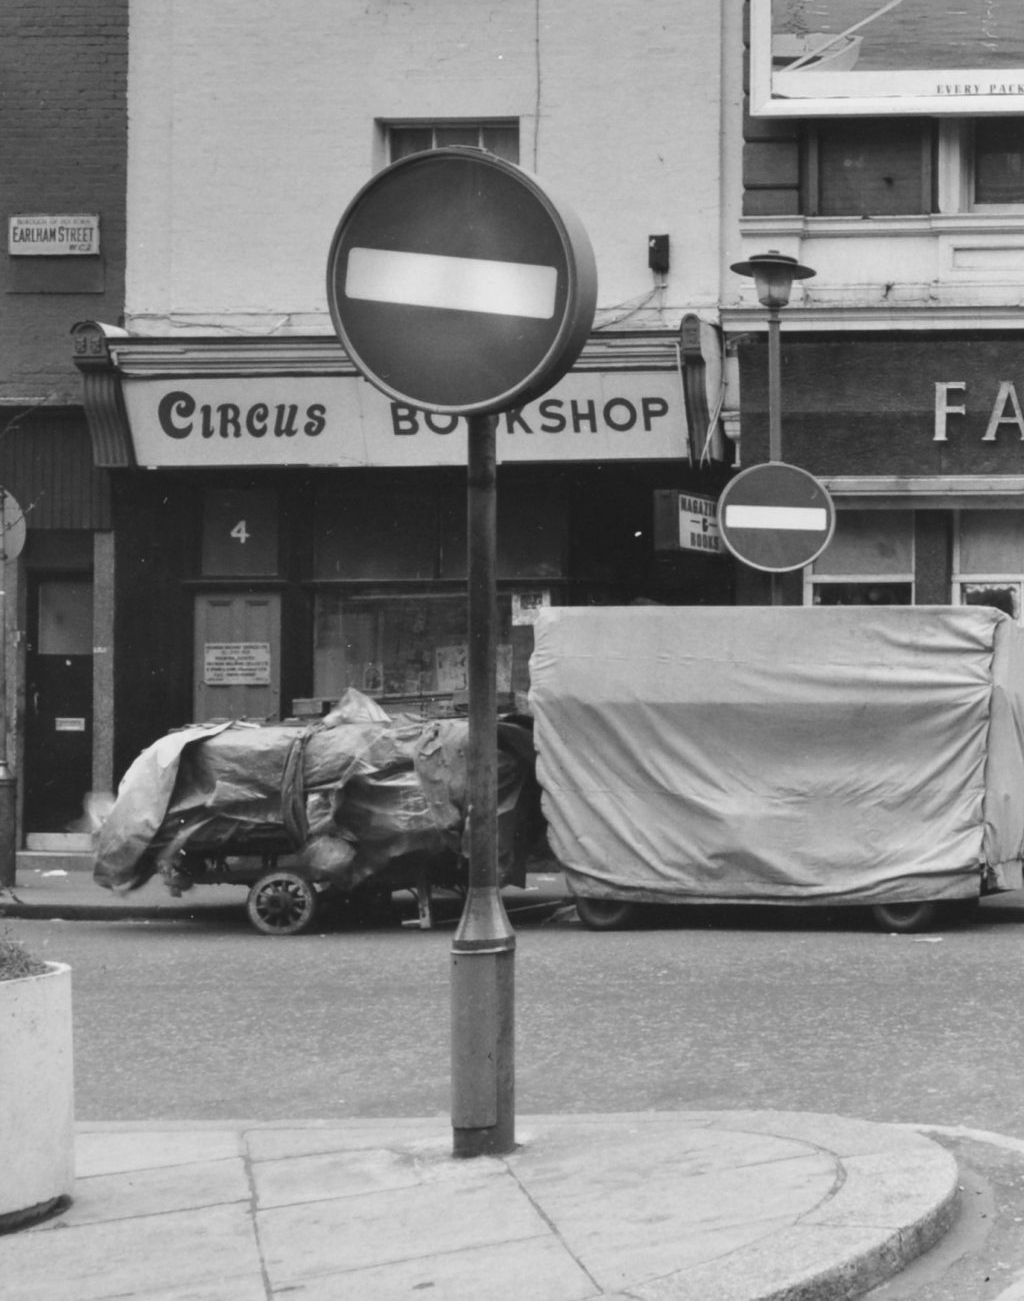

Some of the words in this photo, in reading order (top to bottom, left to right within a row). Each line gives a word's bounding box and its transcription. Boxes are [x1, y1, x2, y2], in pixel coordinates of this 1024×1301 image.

[936, 84, 980, 94] EVERY
[13, 226, 57, 243] EARLHAM
[58, 226, 94, 243] STREET
[389, 397, 670, 436] BOKSHOP
[681, 496, 718, 519] MAGAZIN
[230, 519, 251, 544] 4
[690, 532, 719, 551] BOOKS
